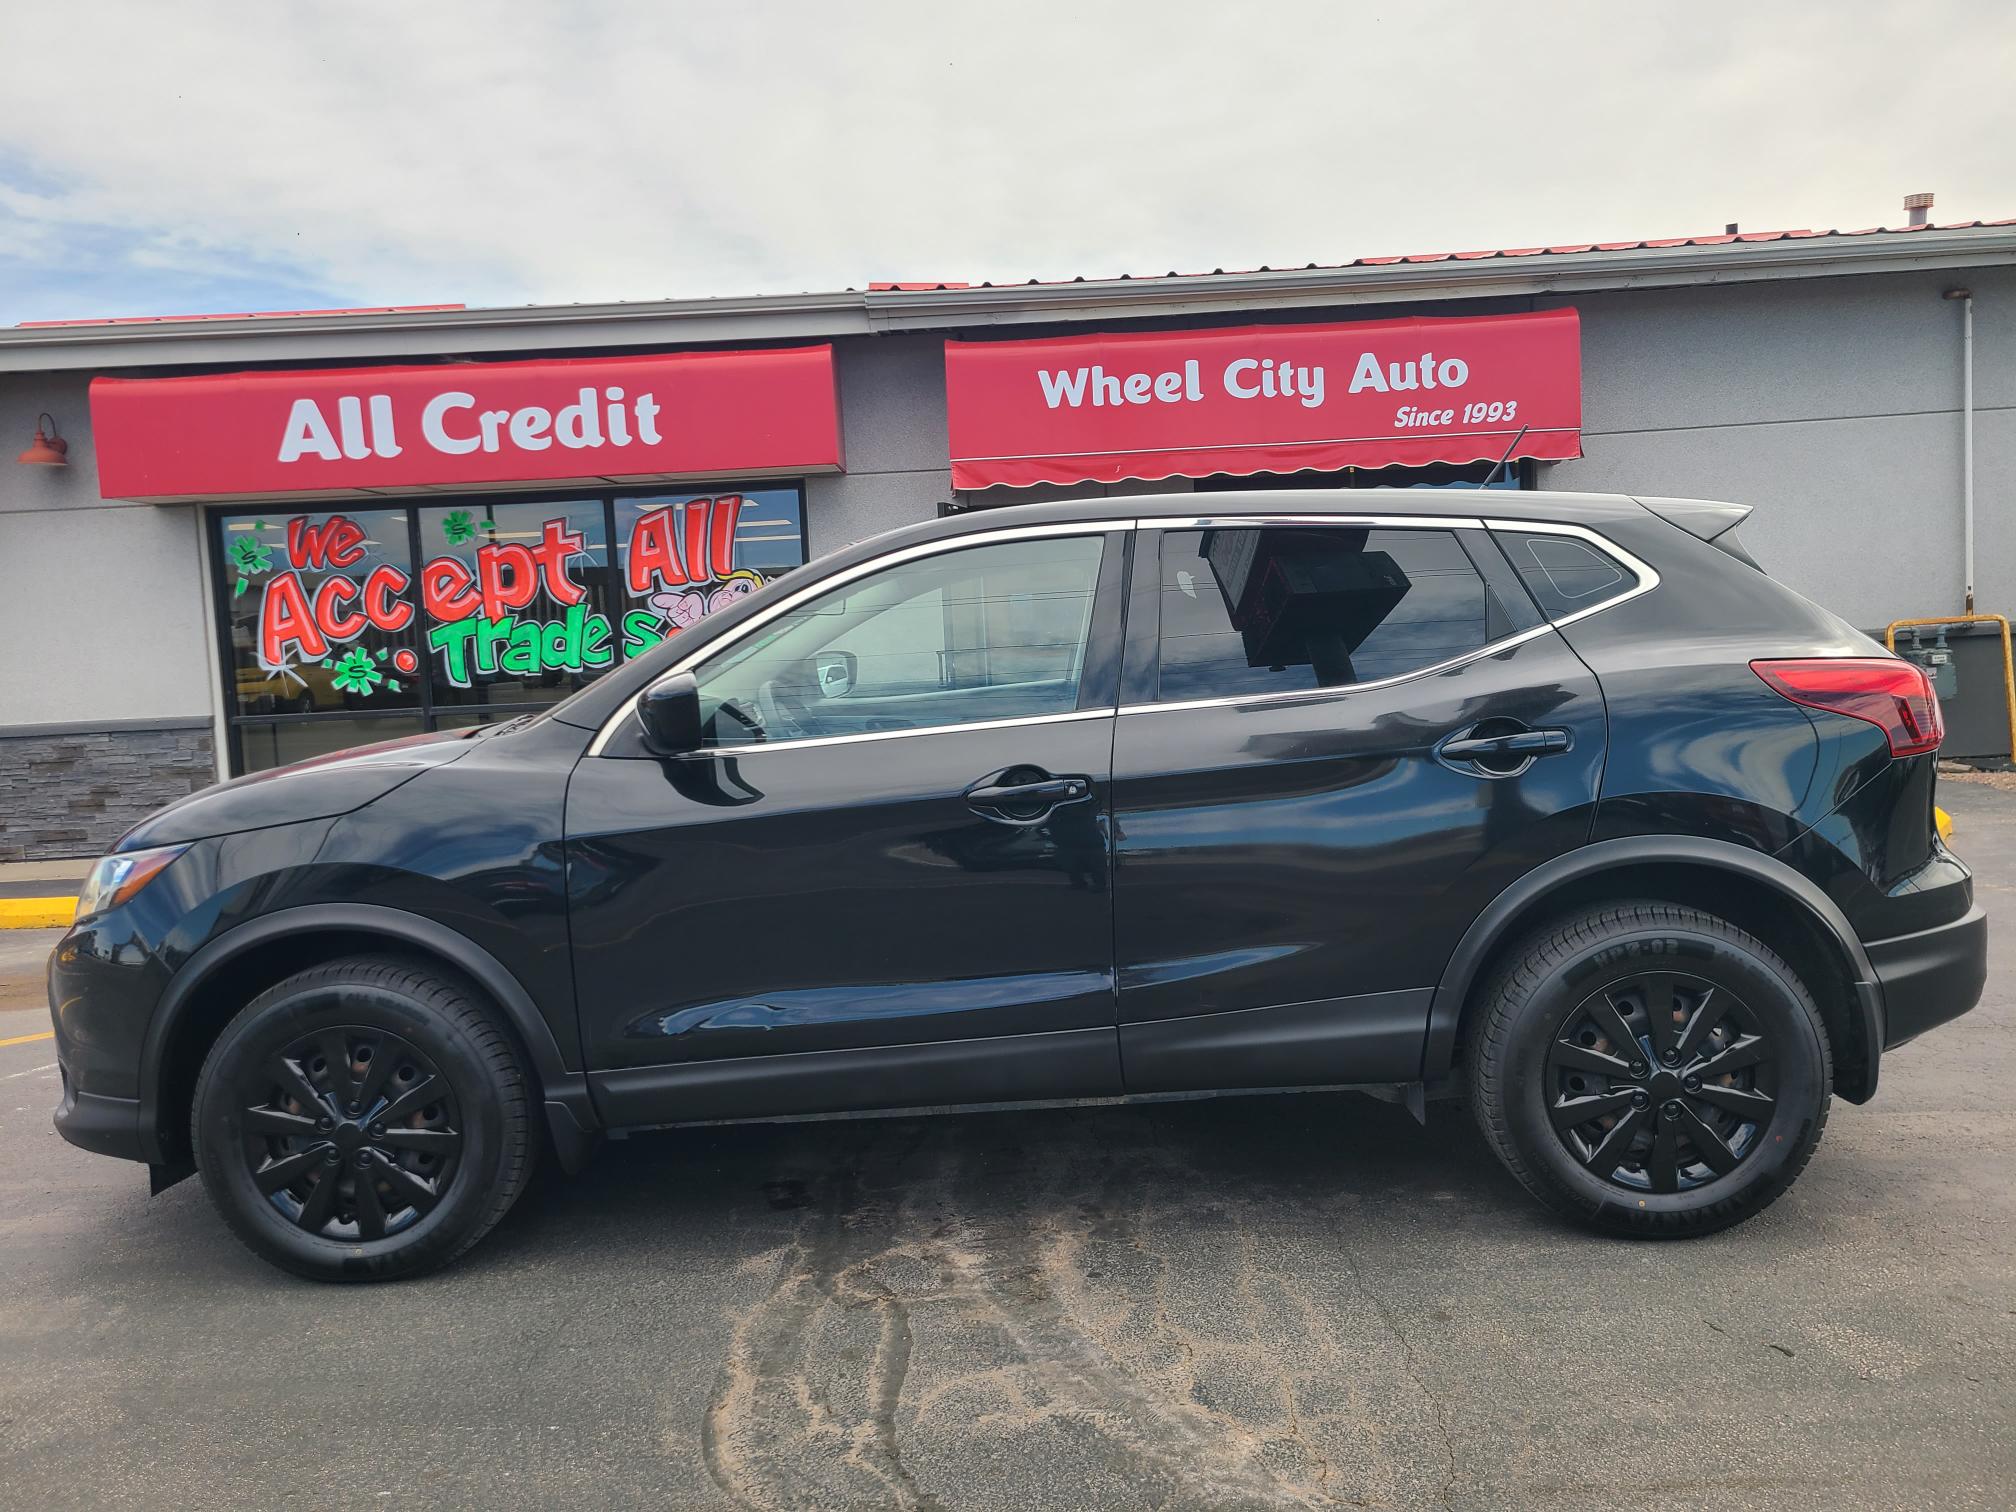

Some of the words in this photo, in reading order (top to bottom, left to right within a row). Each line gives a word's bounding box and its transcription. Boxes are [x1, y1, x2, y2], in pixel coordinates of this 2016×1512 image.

[1037, 359, 1205, 409] Wheel
[1223, 357, 1325, 409] City
[1348, 352, 1470, 395] Auto
[1393, 406, 1455, 428] Since
[1462, 400, 1519, 424] 1993
[277, 394, 403, 463] All
[421, 386, 663, 455] Credit
[287, 515, 367, 570] We
[261, 516, 587, 665] Accept
[629, 495, 743, 592] All
[430, 602, 664, 685] Trades
